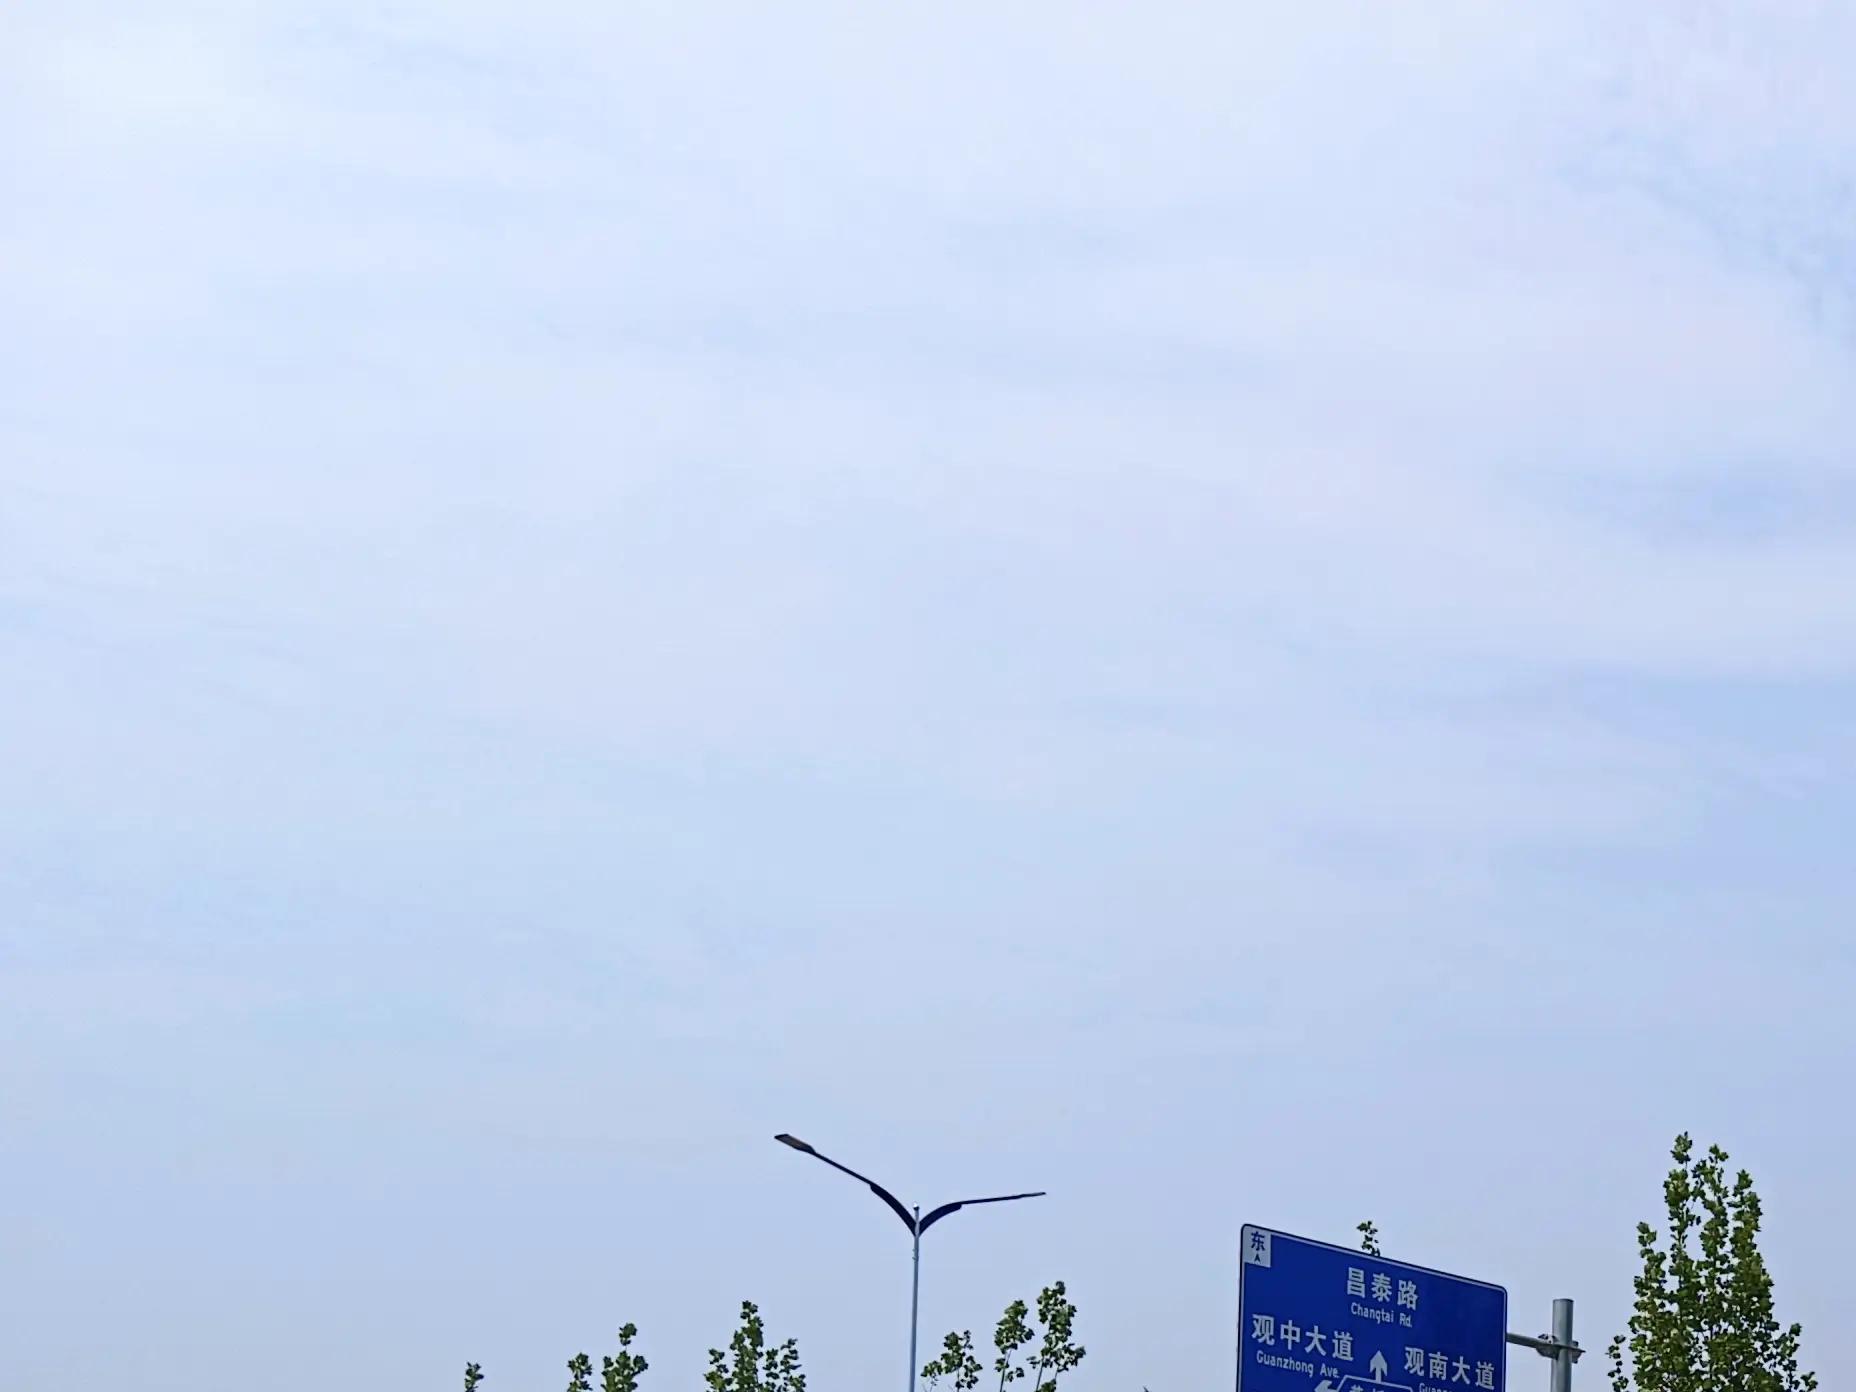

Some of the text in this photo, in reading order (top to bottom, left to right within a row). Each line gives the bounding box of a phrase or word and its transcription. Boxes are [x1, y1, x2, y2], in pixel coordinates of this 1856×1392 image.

[1250, 1231, 1265, 1251] 东
[1346, 1266, 1419, 1311] 昌泰路
[1350, 1301, 1395, 1325] Changtai
[1251, 1313, 1354, 1362] 观中大道
[1256, 1350, 1314, 1377] Guanzhong
[1403, 1346, 1495, 1391] 观南大道
